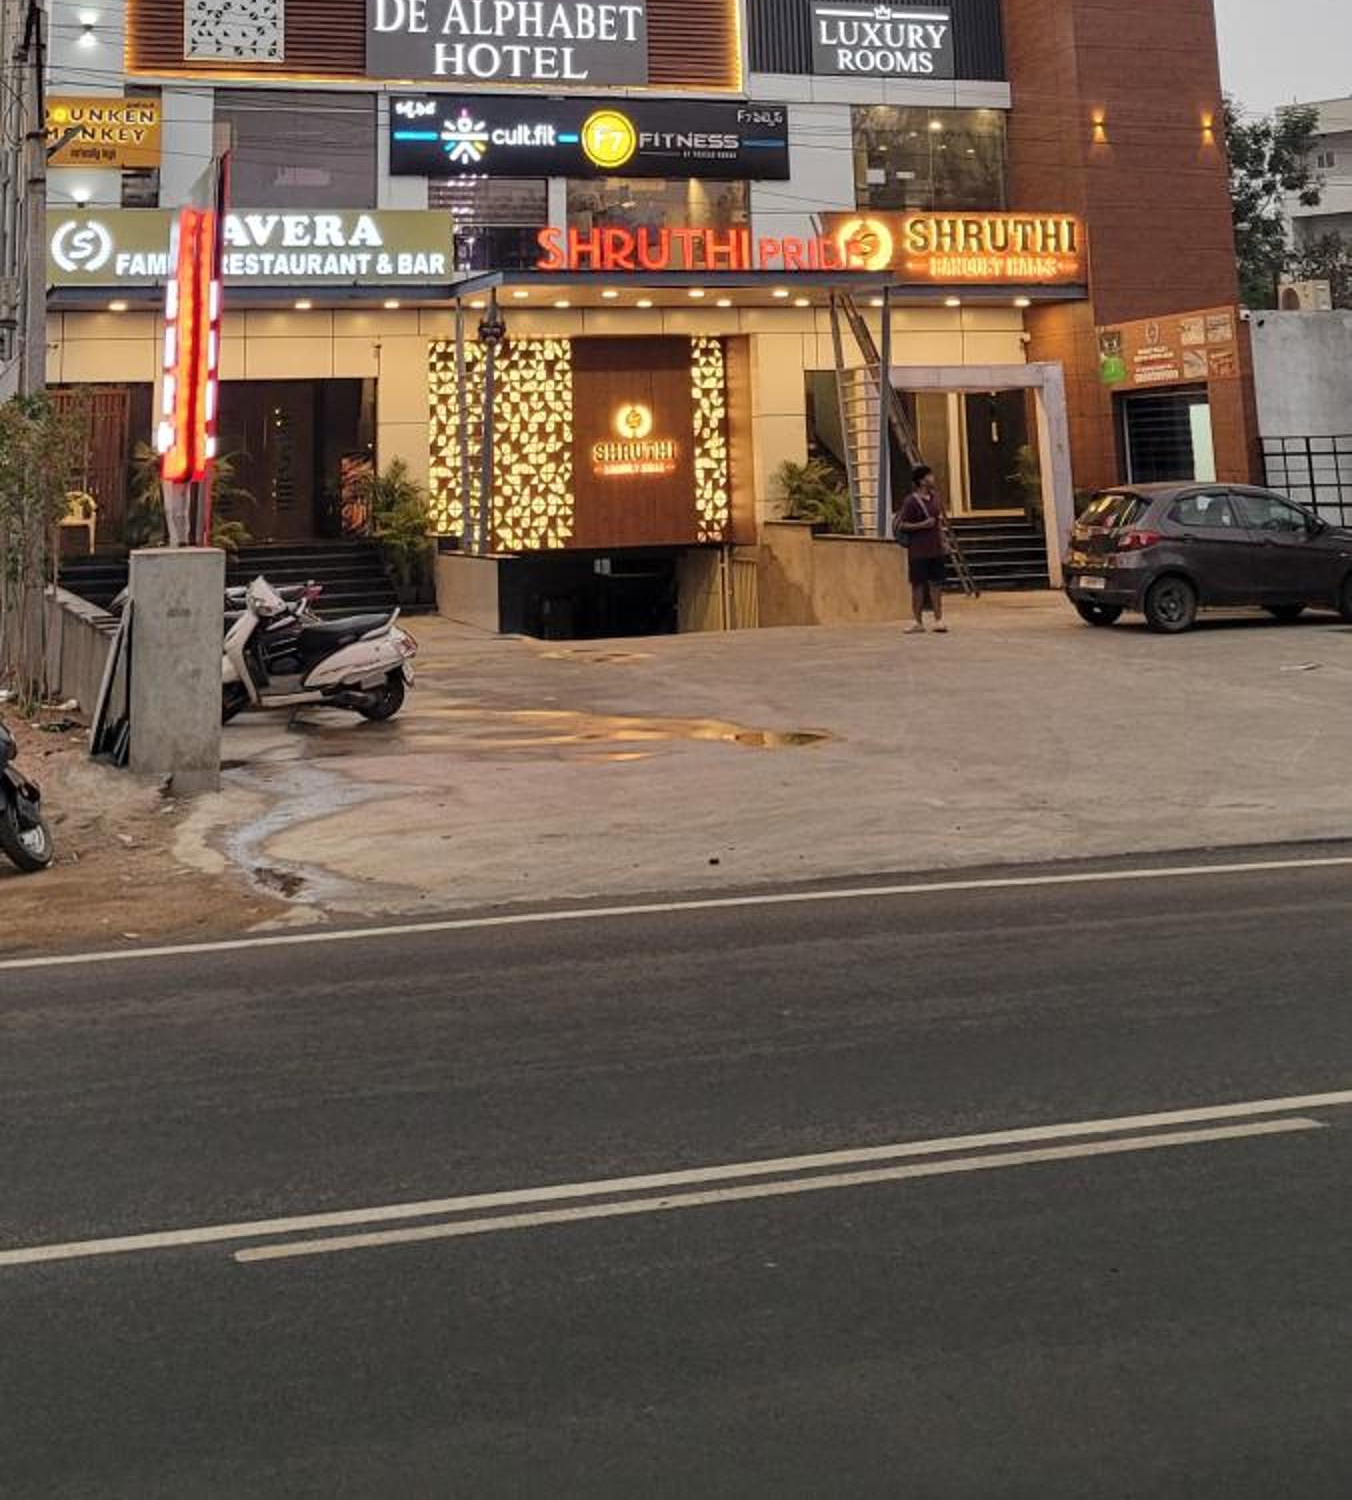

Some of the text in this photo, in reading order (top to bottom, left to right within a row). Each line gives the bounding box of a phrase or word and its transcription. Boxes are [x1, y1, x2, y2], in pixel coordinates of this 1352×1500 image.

[819, 19, 948, 49] LUXURY
[433, 43, 589, 79] HOTEL
[837, 48, 934, 73] ROOMS
[46, 109, 154, 123] UNKEN
[491, 123, 557, 146] cult.fit
[639, 132, 739, 149] FITNESS
[223, 214, 383, 247] AVERA
[908, 218, 1077, 253] SHRUTHI
[537, 227, 750, 270] SHRUTHI
[115, 253, 445, 276] FAM RESTAURANT & BAR
